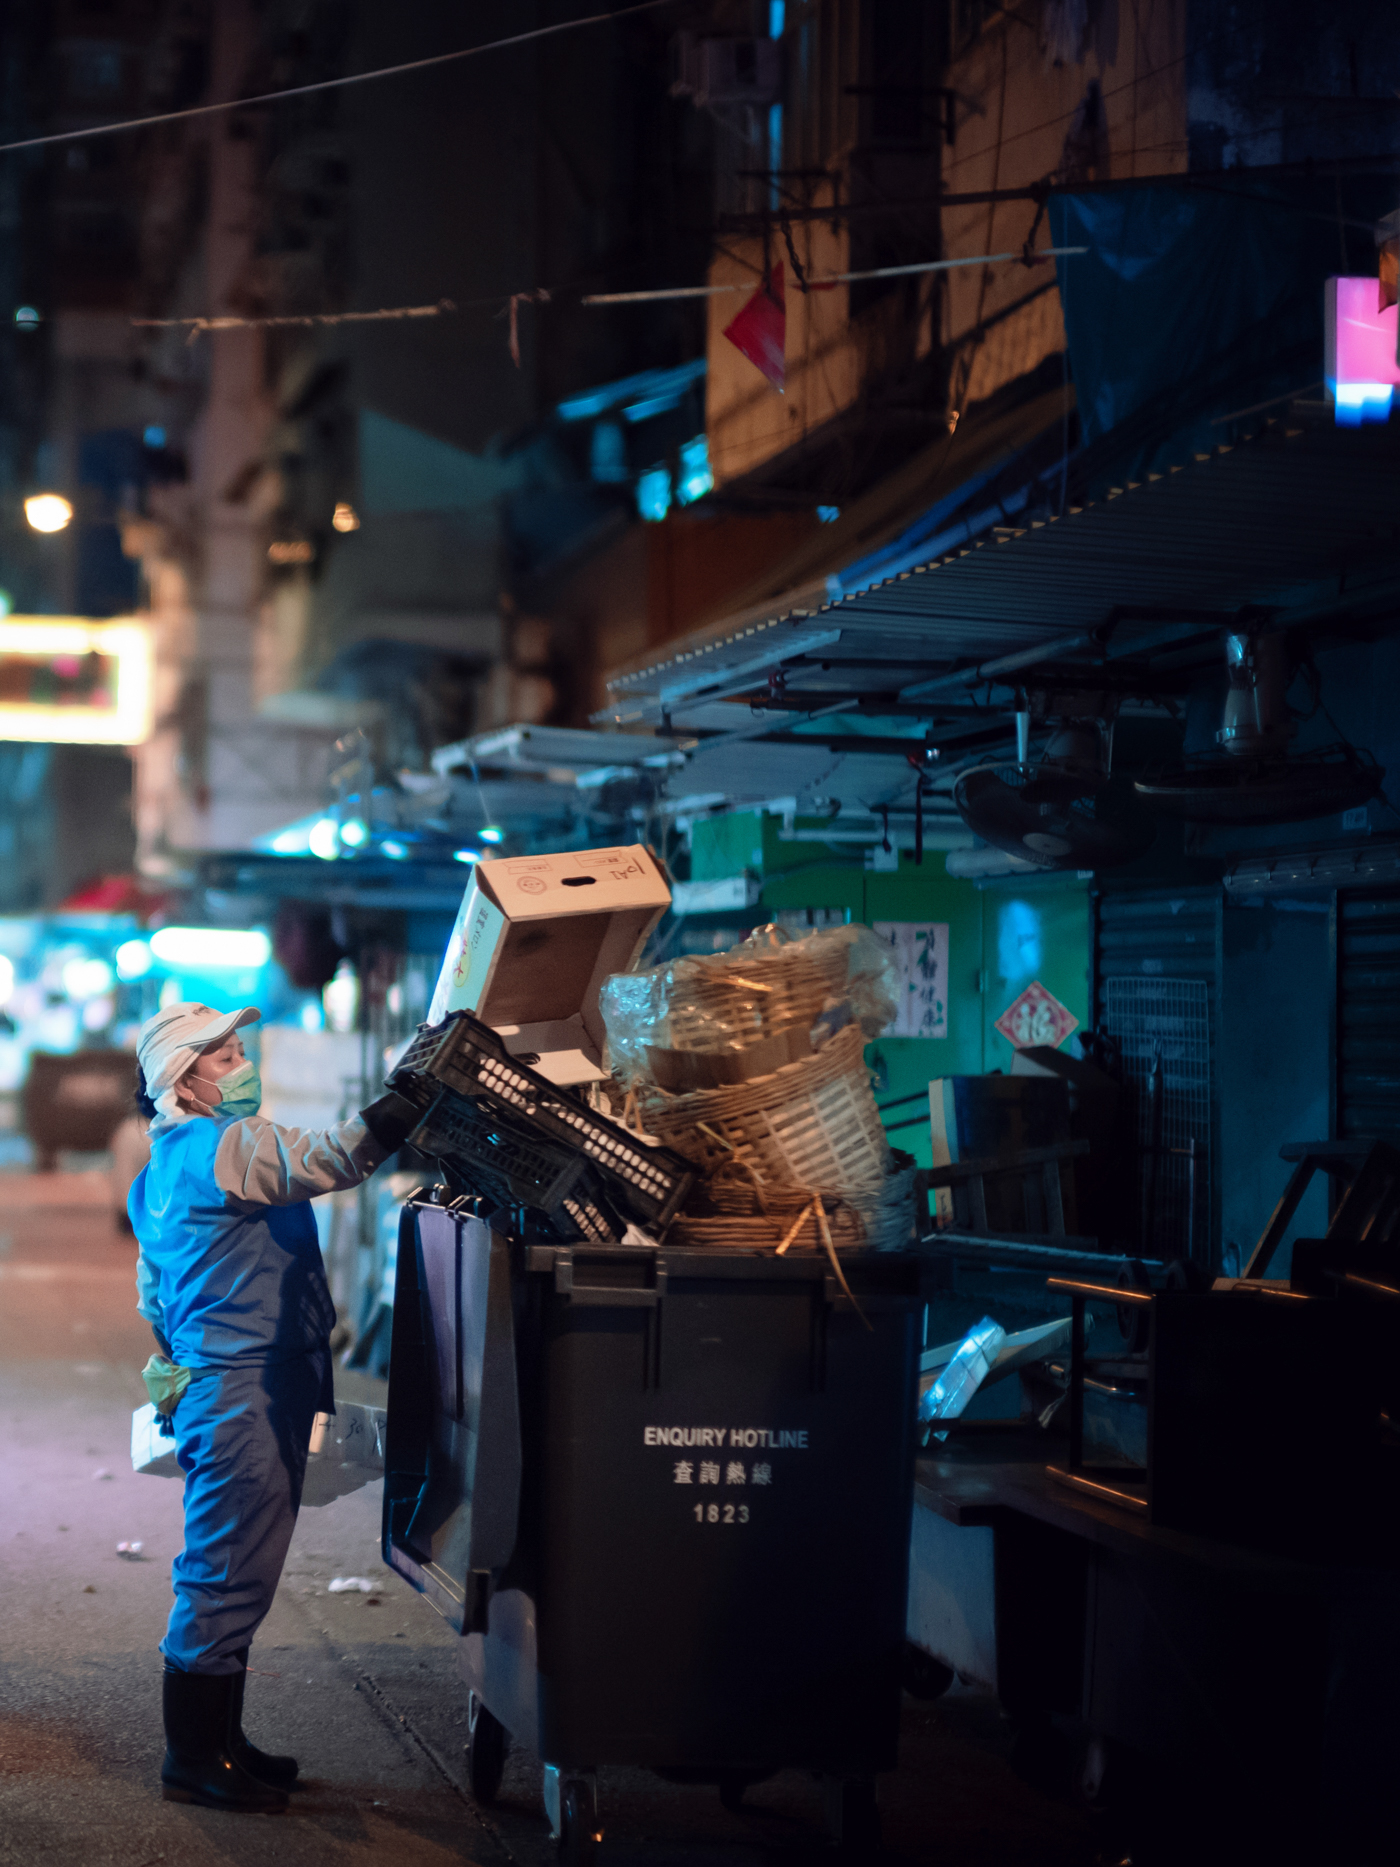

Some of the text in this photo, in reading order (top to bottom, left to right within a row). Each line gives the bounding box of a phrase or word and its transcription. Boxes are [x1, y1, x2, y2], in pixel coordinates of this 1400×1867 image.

[643, 1426, 809, 1448] ENQUIRY HOTLINE
[673, 1460, 773, 1485] 查詢熱線
[693, 1503, 750, 1524] 1823
